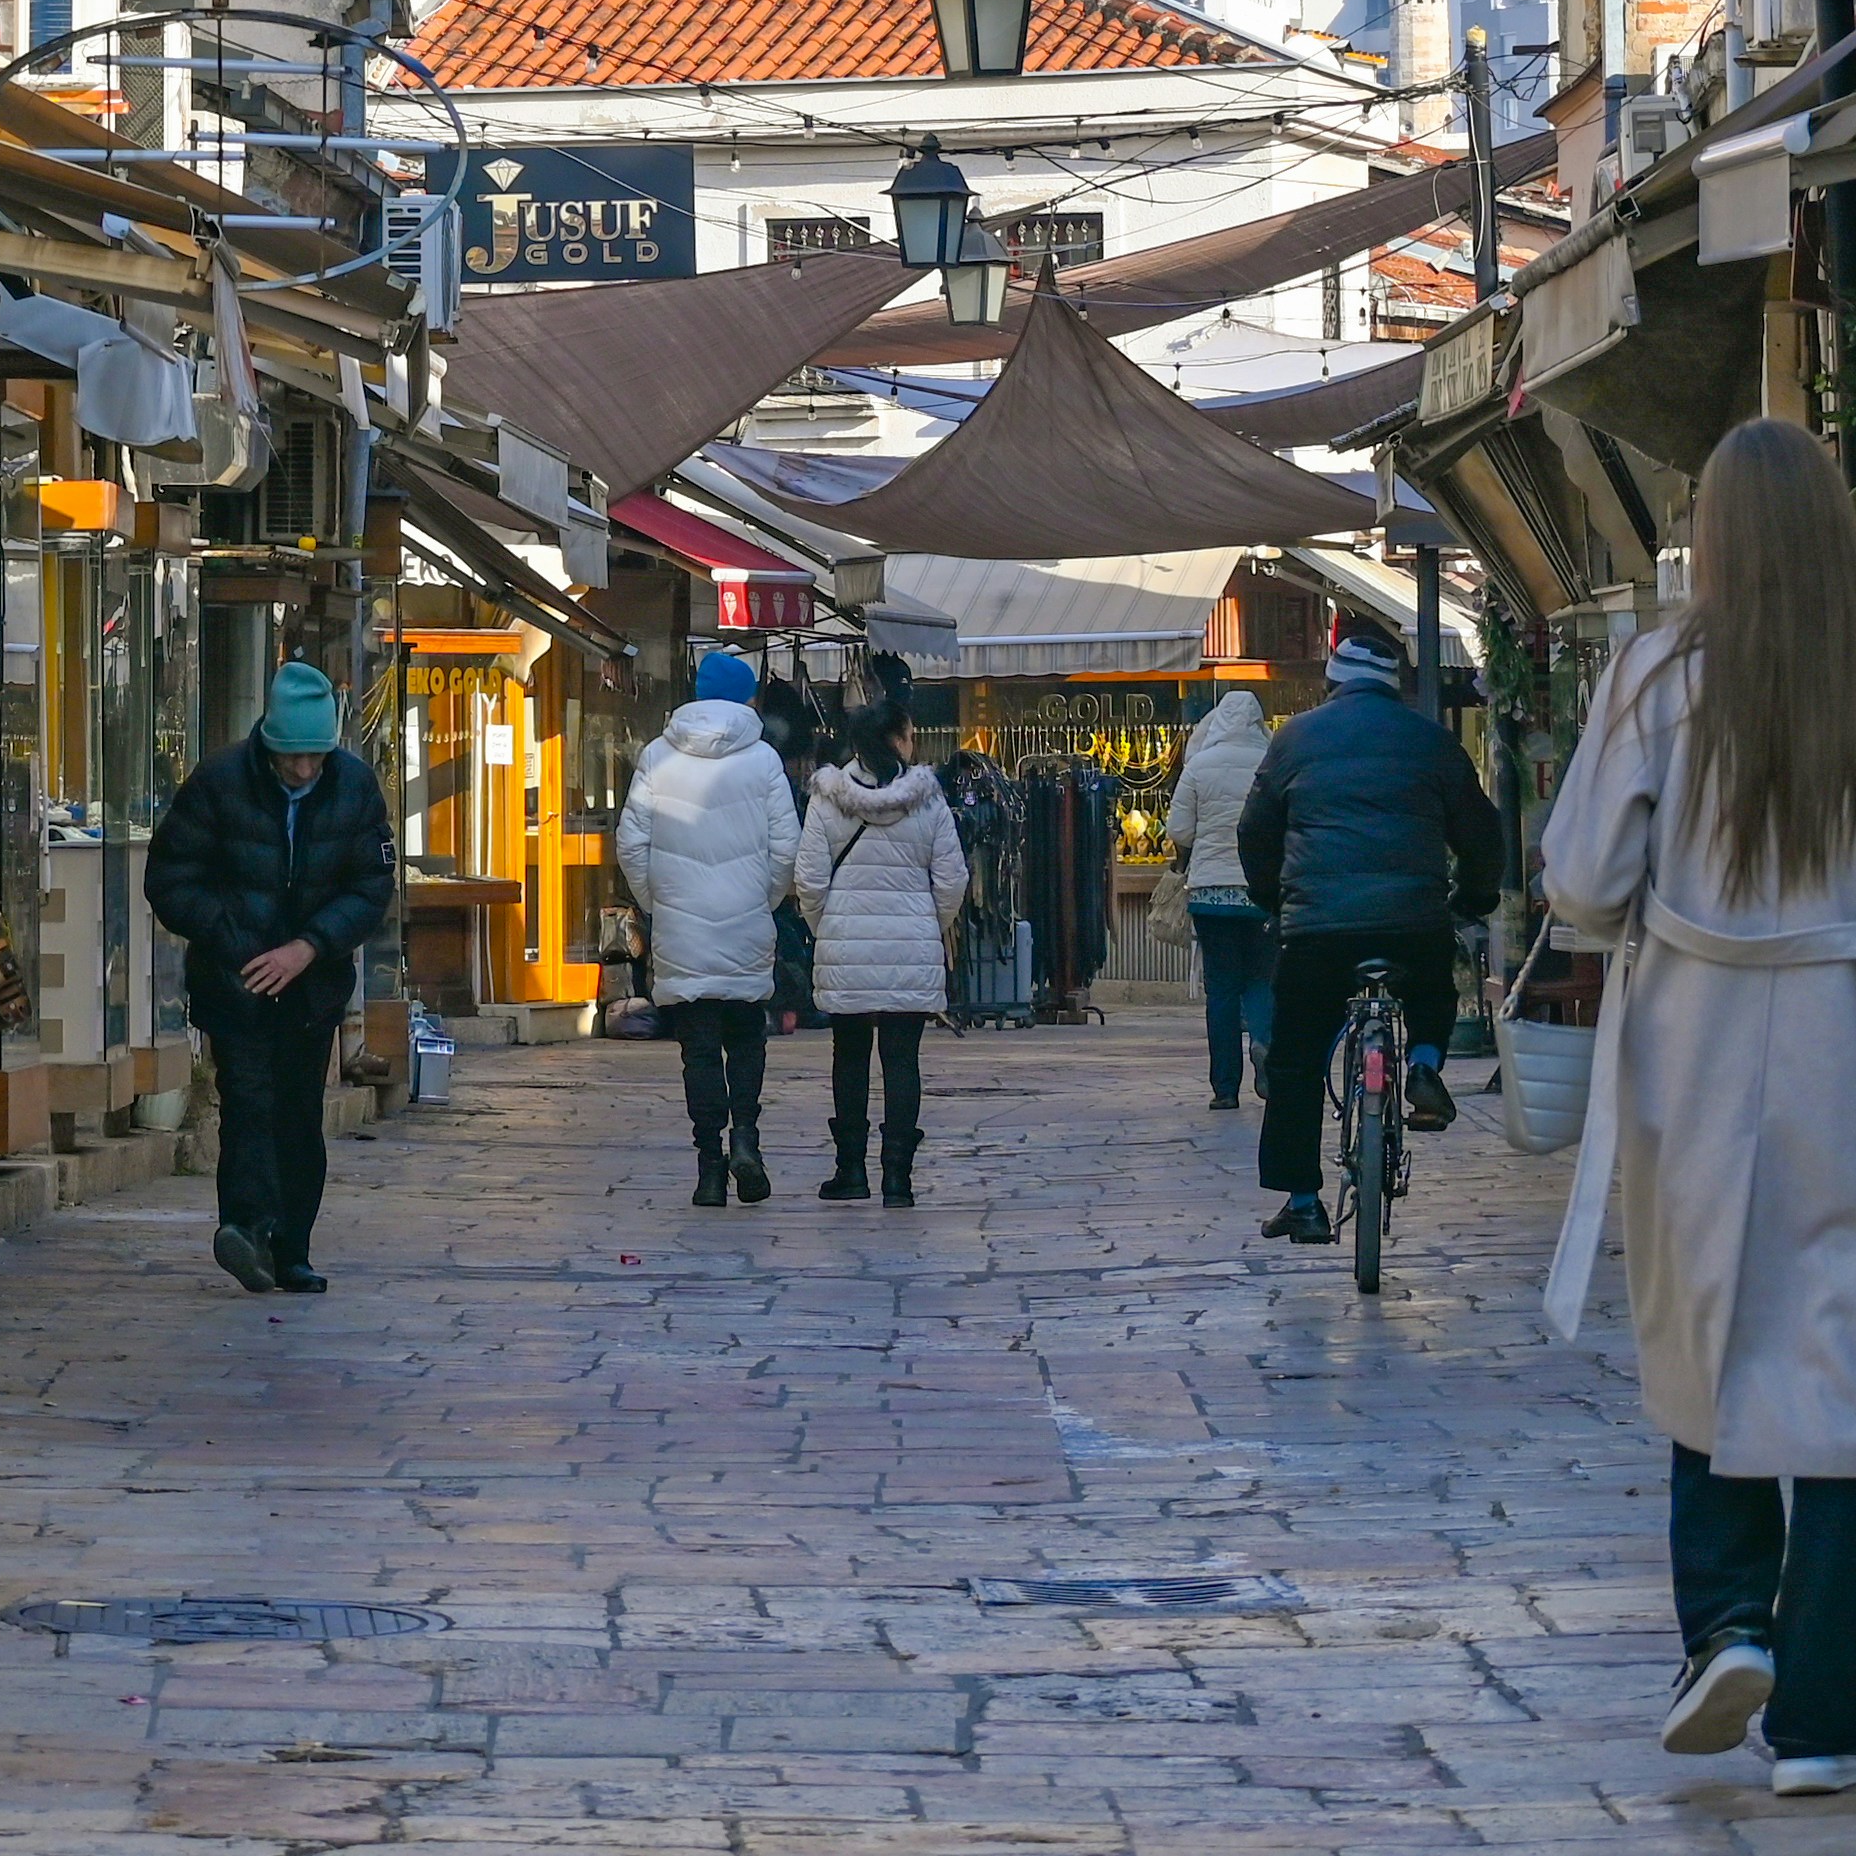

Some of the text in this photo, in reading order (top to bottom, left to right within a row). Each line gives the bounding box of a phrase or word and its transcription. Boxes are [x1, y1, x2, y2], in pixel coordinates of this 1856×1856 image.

[465, 193, 658, 275] JUSUF
[525, 241, 660, 265] GOLD
[407, 666, 502, 696] EKO GOLD
